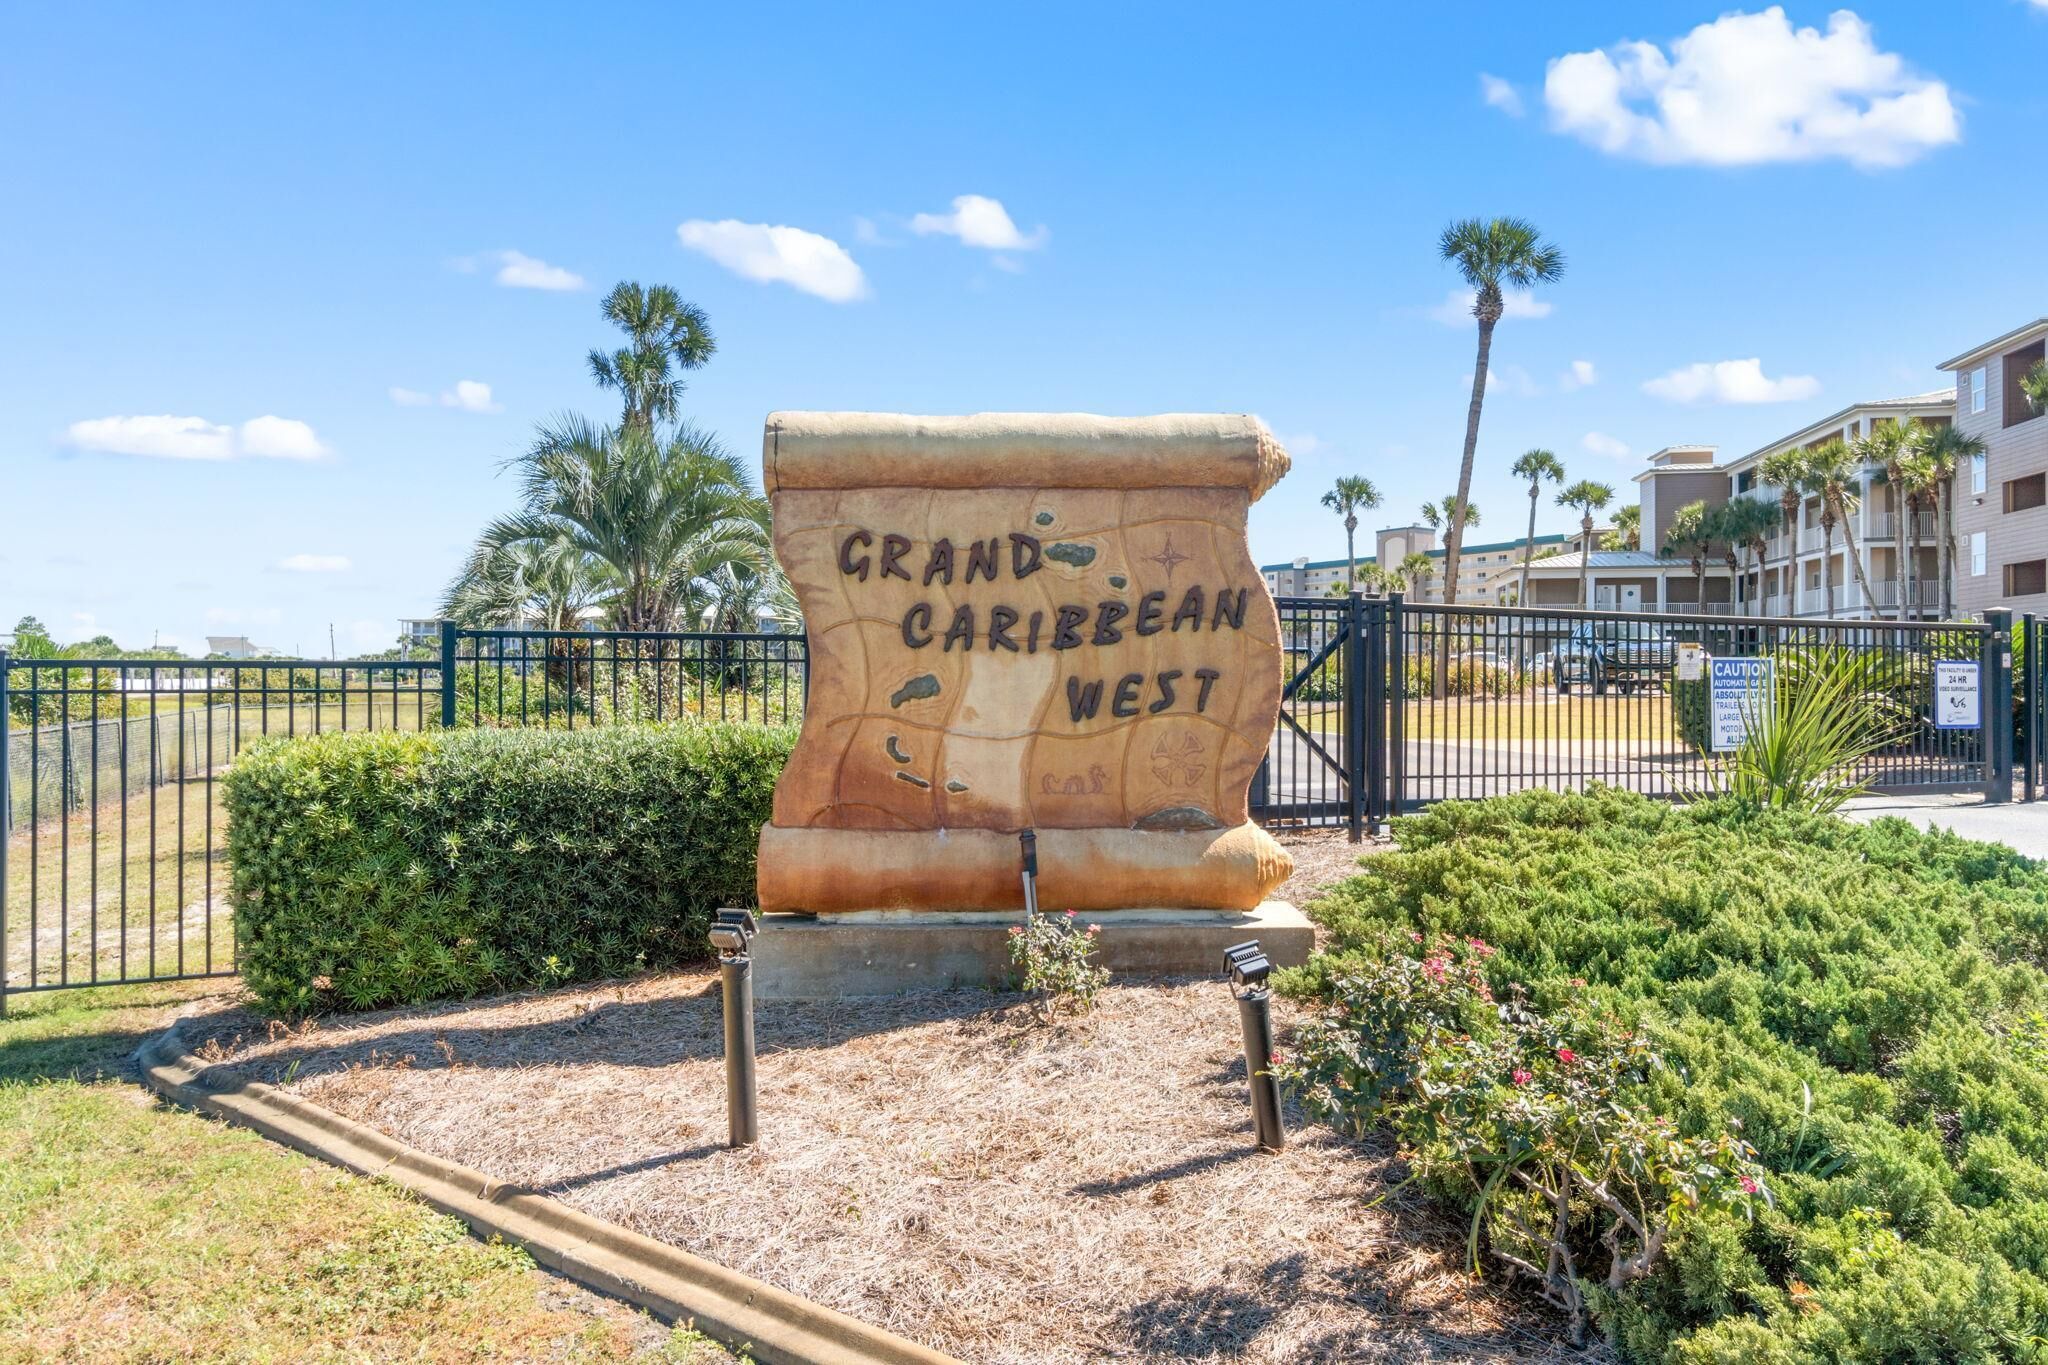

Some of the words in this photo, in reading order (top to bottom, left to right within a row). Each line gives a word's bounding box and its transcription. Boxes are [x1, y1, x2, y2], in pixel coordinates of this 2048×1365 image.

[840, 530, 1042, 586] GRAND
[902, 584, 1248, 654] CARIBBEAN
[1715, 663, 1769, 676] CAUTION
[1714, 679, 1749, 687] AUTOMATI
[1750, 679, 1767, 687] GAE
[1067, 668, 1220, 723] WEST
[1715, 690, 1759, 699] ABSOLUTLY
[1719, 713, 1740, 721] LARGE
